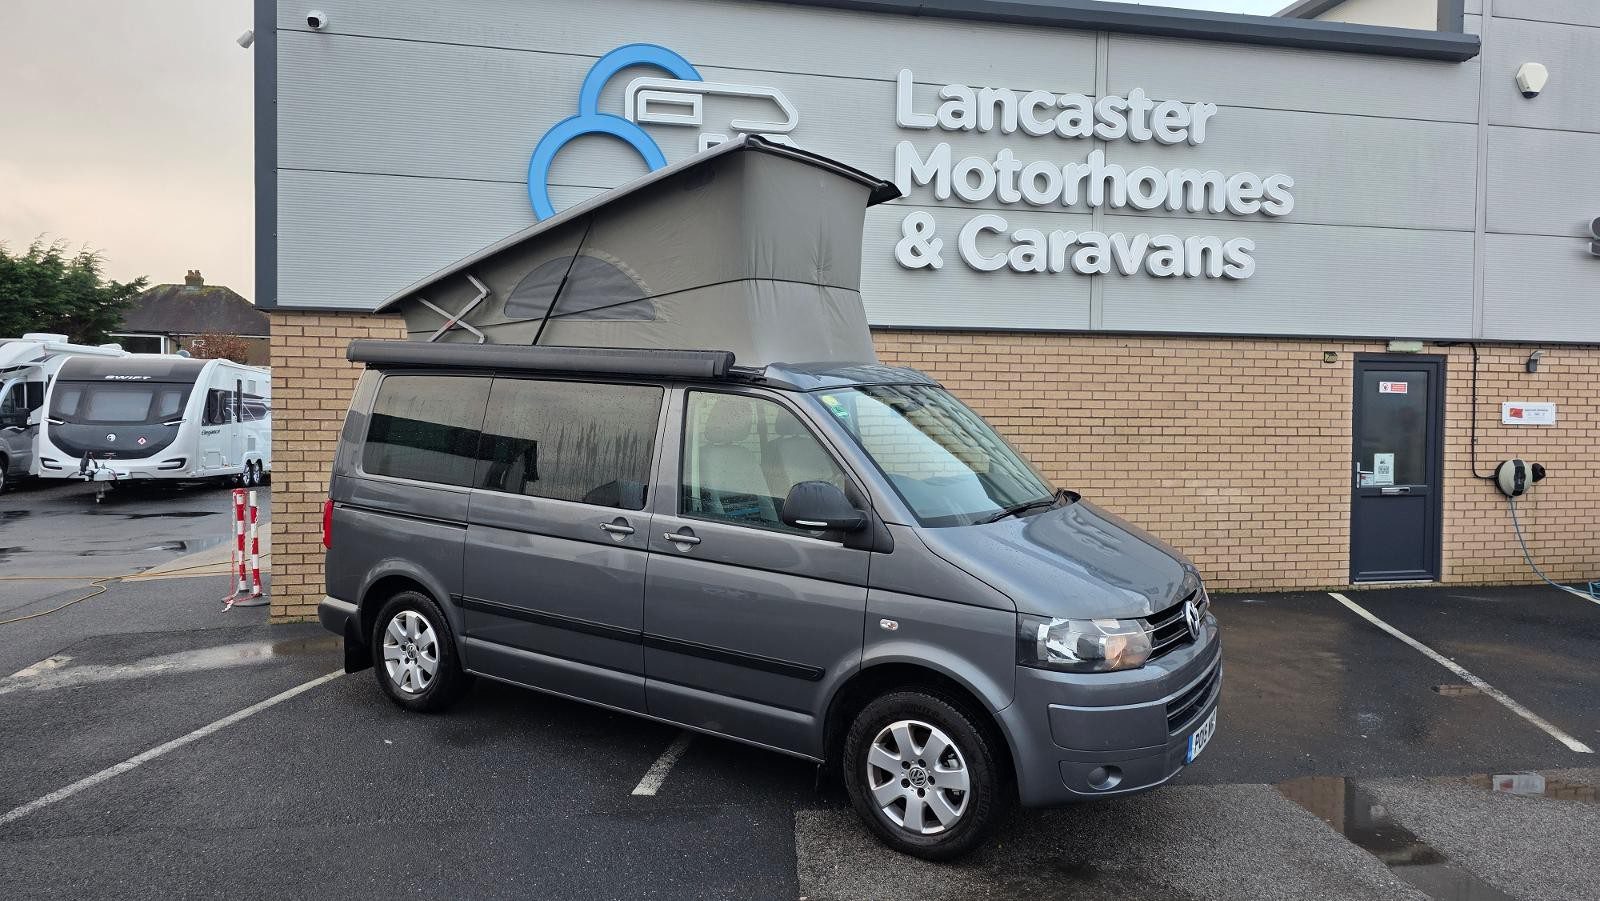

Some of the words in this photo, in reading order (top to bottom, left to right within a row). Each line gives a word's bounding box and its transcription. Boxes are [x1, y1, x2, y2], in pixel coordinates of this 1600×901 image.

[896, 68, 1217, 145] Lancaster
[895, 140, 1295, 217] Motorhomes
[895, 211, 943, 270] &
[958, 214, 1256, 280] Caravans
